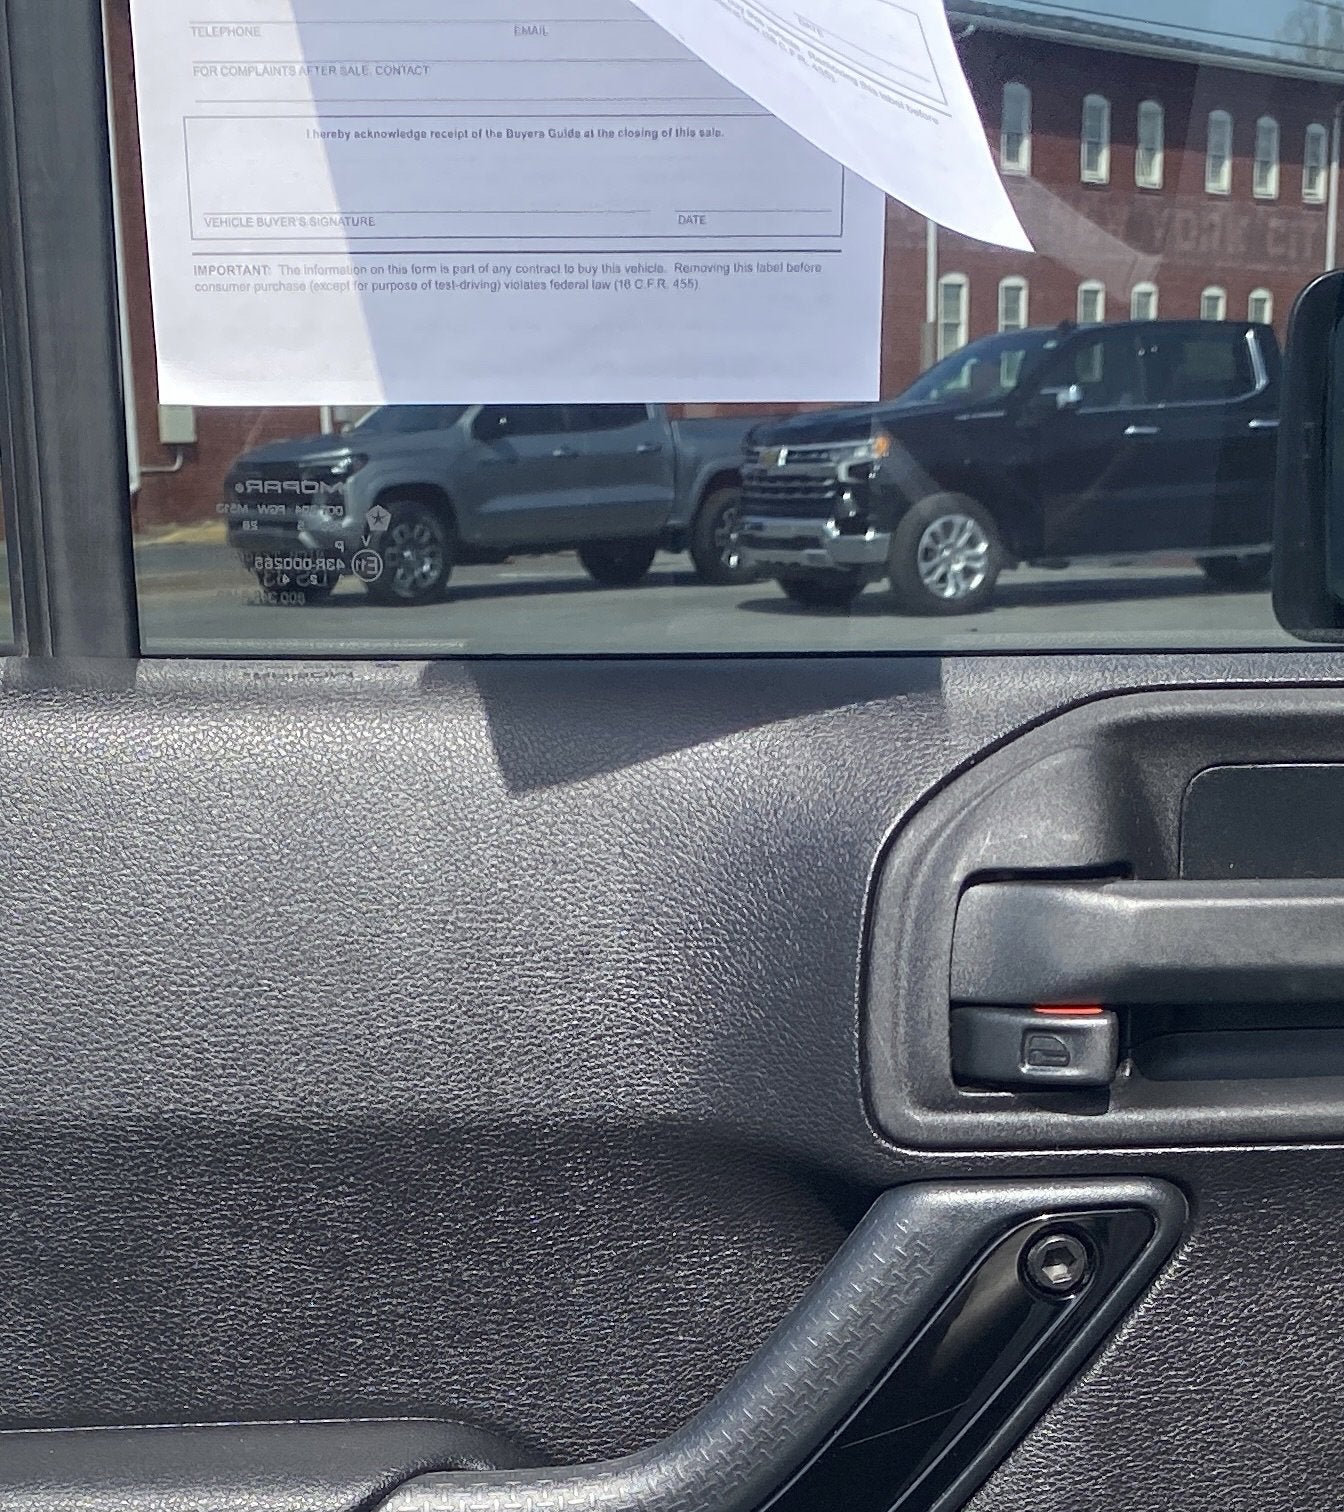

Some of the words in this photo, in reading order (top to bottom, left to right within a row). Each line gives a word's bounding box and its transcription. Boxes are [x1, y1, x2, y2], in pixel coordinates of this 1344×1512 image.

[190, 25, 262, 38] TELEPHONE
[513, 24, 549, 37] EMAIL
[193, 65, 218, 77] FOR
[220, 64, 296, 77] COMPLAINTS
[299, 64, 336, 76] AFTER
[312, 128, 351, 141] hereby
[353, 127, 427, 141] acknowledge
[430, 127, 468, 141] receipt
[471, 127, 484, 138] of
[485, 127, 503, 138] the
[506, 126, 545, 141] Buyers
[548, 126, 581, 138] Guide
[583, 127, 595, 138] at
[597, 126, 616, 138] the
[618, 126, 658, 141] closing
[661, 126, 674, 137] of
[675, 126, 697, 137] this
[698, 126, 725, 138] sale.
[203, 216, 254, 229] VEHICLE
[256, 216, 307, 229] BUYER'S
[309, 216, 377, 229] SIGNATURE
[678, 214, 708, 226] DATE
[193, 264, 272, 277] IMPORTANT:
[278, 264, 301, 276] The
[303, 264, 369, 276] information
[370, 265, 385, 275] on
[387, 263, 409, 275] this
[411, 263, 437, 275] form
[440, 263, 450, 275] is
[452, 263, 476, 278] part
[478, 263, 490, 274] of
[491, 265, 513, 277] any
[515, 263, 561, 274] contract
[564, 263, 576, 274] to
[577, 262, 598, 277] buy
[601, 262, 621, 273] this
[674, 262, 731, 277] Removing
[733, 262, 754, 274] this
[756, 262, 783, 274] label
[786, 261, 823, 274] before
[194, 283, 251, 293] consumer
[254, 281, 307, 295] purchase
[309, 280, 351, 295] (except
[353, 280, 369, 292] for
[371, 282, 419, 294] purpose
[420, 280, 433, 292] of
[434, 279, 502, 294] test-driving)
[504, 279, 547, 292] violates
[549, 279, 588, 291] federal
[591, 279, 611, 291] law
